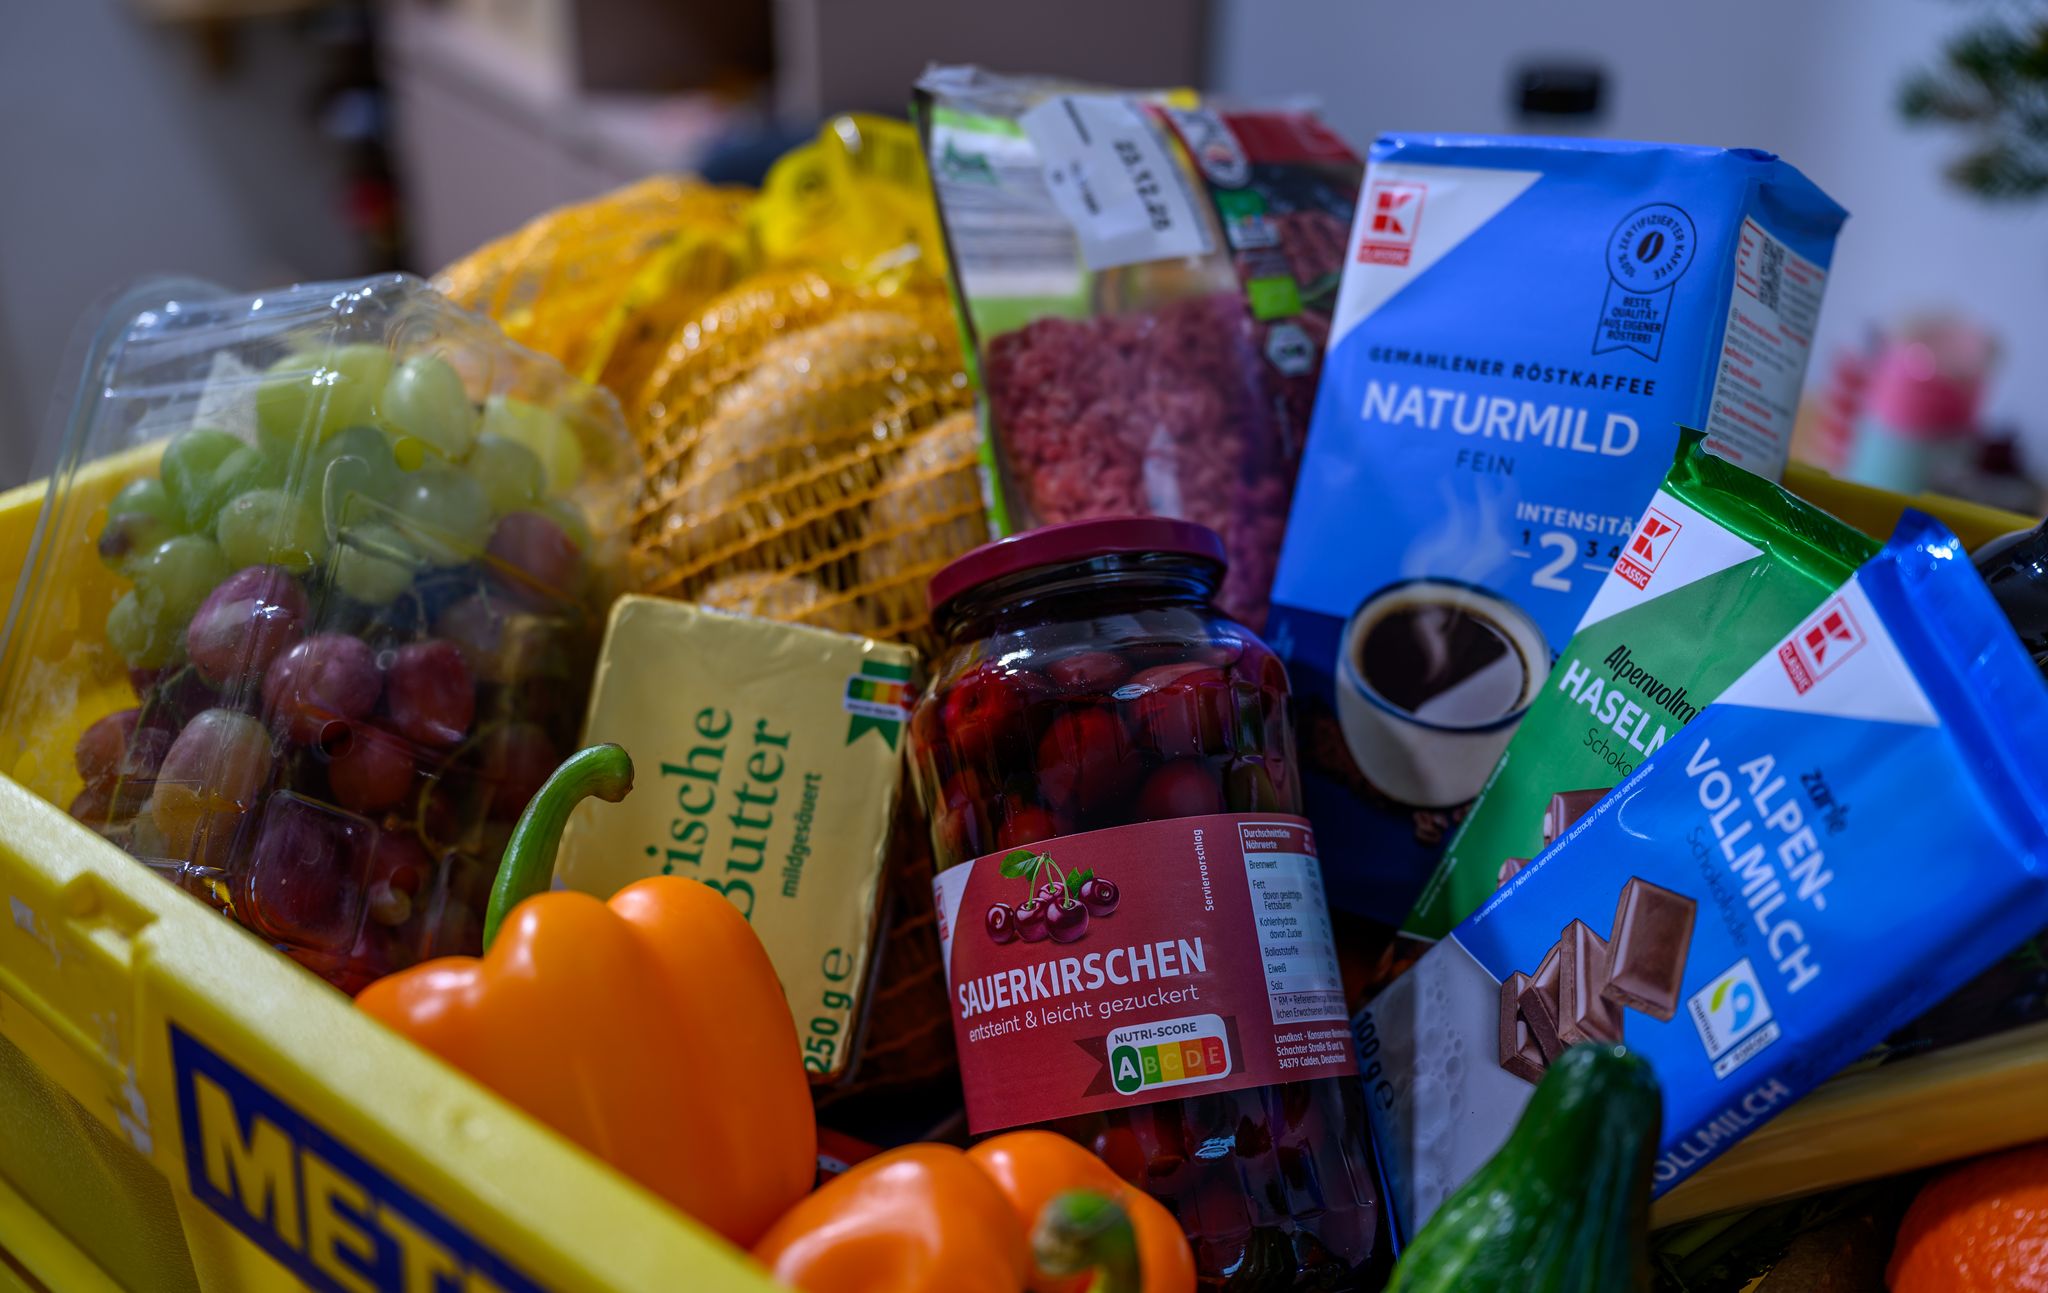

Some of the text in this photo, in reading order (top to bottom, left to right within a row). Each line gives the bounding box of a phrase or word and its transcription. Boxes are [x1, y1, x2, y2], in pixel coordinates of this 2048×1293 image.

[1619, 214, 1685, 250] ZERTIFIZIERTER
[1653, 244, 1685, 280] KAFFEE
[1611, 307, 1658, 321] QUALITÄT
[1623, 296, 1652, 309] BESTE
[1603, 318, 1661, 333] AUS EIGENER
[1607, 330, 1652, 345] RÖSTEREI
[1369, 346, 1656, 396] GEMAHLENER RÖSTKAFFEE
[1361, 379, 1640, 457] NATURMILD
[1456, 448, 1515, 476] FEIN
[1515, 502, 1637, 537] INTENSITÄ
[1522, 529, 1620, 592] 1 2 3 4
[1617, 560, 1649, 588] CLASSIC
[1583, 728, 1638, 778] Schoko
[646, 706, 733, 884] ische
[1800, 767, 1848, 836] zarte
[781, 772, 823, 898] mildgesäuert
[1244, 829, 1291, 838] Durchschnittliche
[1245, 840, 1277, 849] Nährwerte
[1738, 754, 1834, 911] ALPEN-
[1194, 829, 1215, 911] Serviervorschlag
[1249, 860, 1277, 869] Brennwert
[1685, 738, 1821, 994] VOLLMILCH
[1253, 880, 1266, 889] Fett
[1687, 826, 1748, 948] Schokolade
[1260, 917, 1297, 928] Kohlenhydrate
[1270, 929, 1286, 939] davon
[1265, 946, 1299, 957] Ballaststoffe
[1268, 963, 1287, 974] Eiweiß
[958, 936, 1207, 1019] SAUERKIRSCHEN
[1271, 980, 1284, 991] Salz
[969, 984, 1200, 1042] entsteint & leicht gezuckert
[804, 1017, 840, 1073] 250
[822, 990, 853, 1010] g
[1115, 1022, 1197, 1044] NUTRI-SCORE
[1274, 1032, 1303, 1044] Landkost
[1276, 1044, 1308, 1056] Schachter
[1308, 1042, 1326, 1053] Straße
[1357, 1012, 1380, 1059] 100
[1118, 1046, 1221, 1081] A B C D E
[1279, 1058, 1299, 1069] 34379
[1651, 1078, 1790, 1191] OLLMILCH
[193, 1070, 506, 1293] MET
